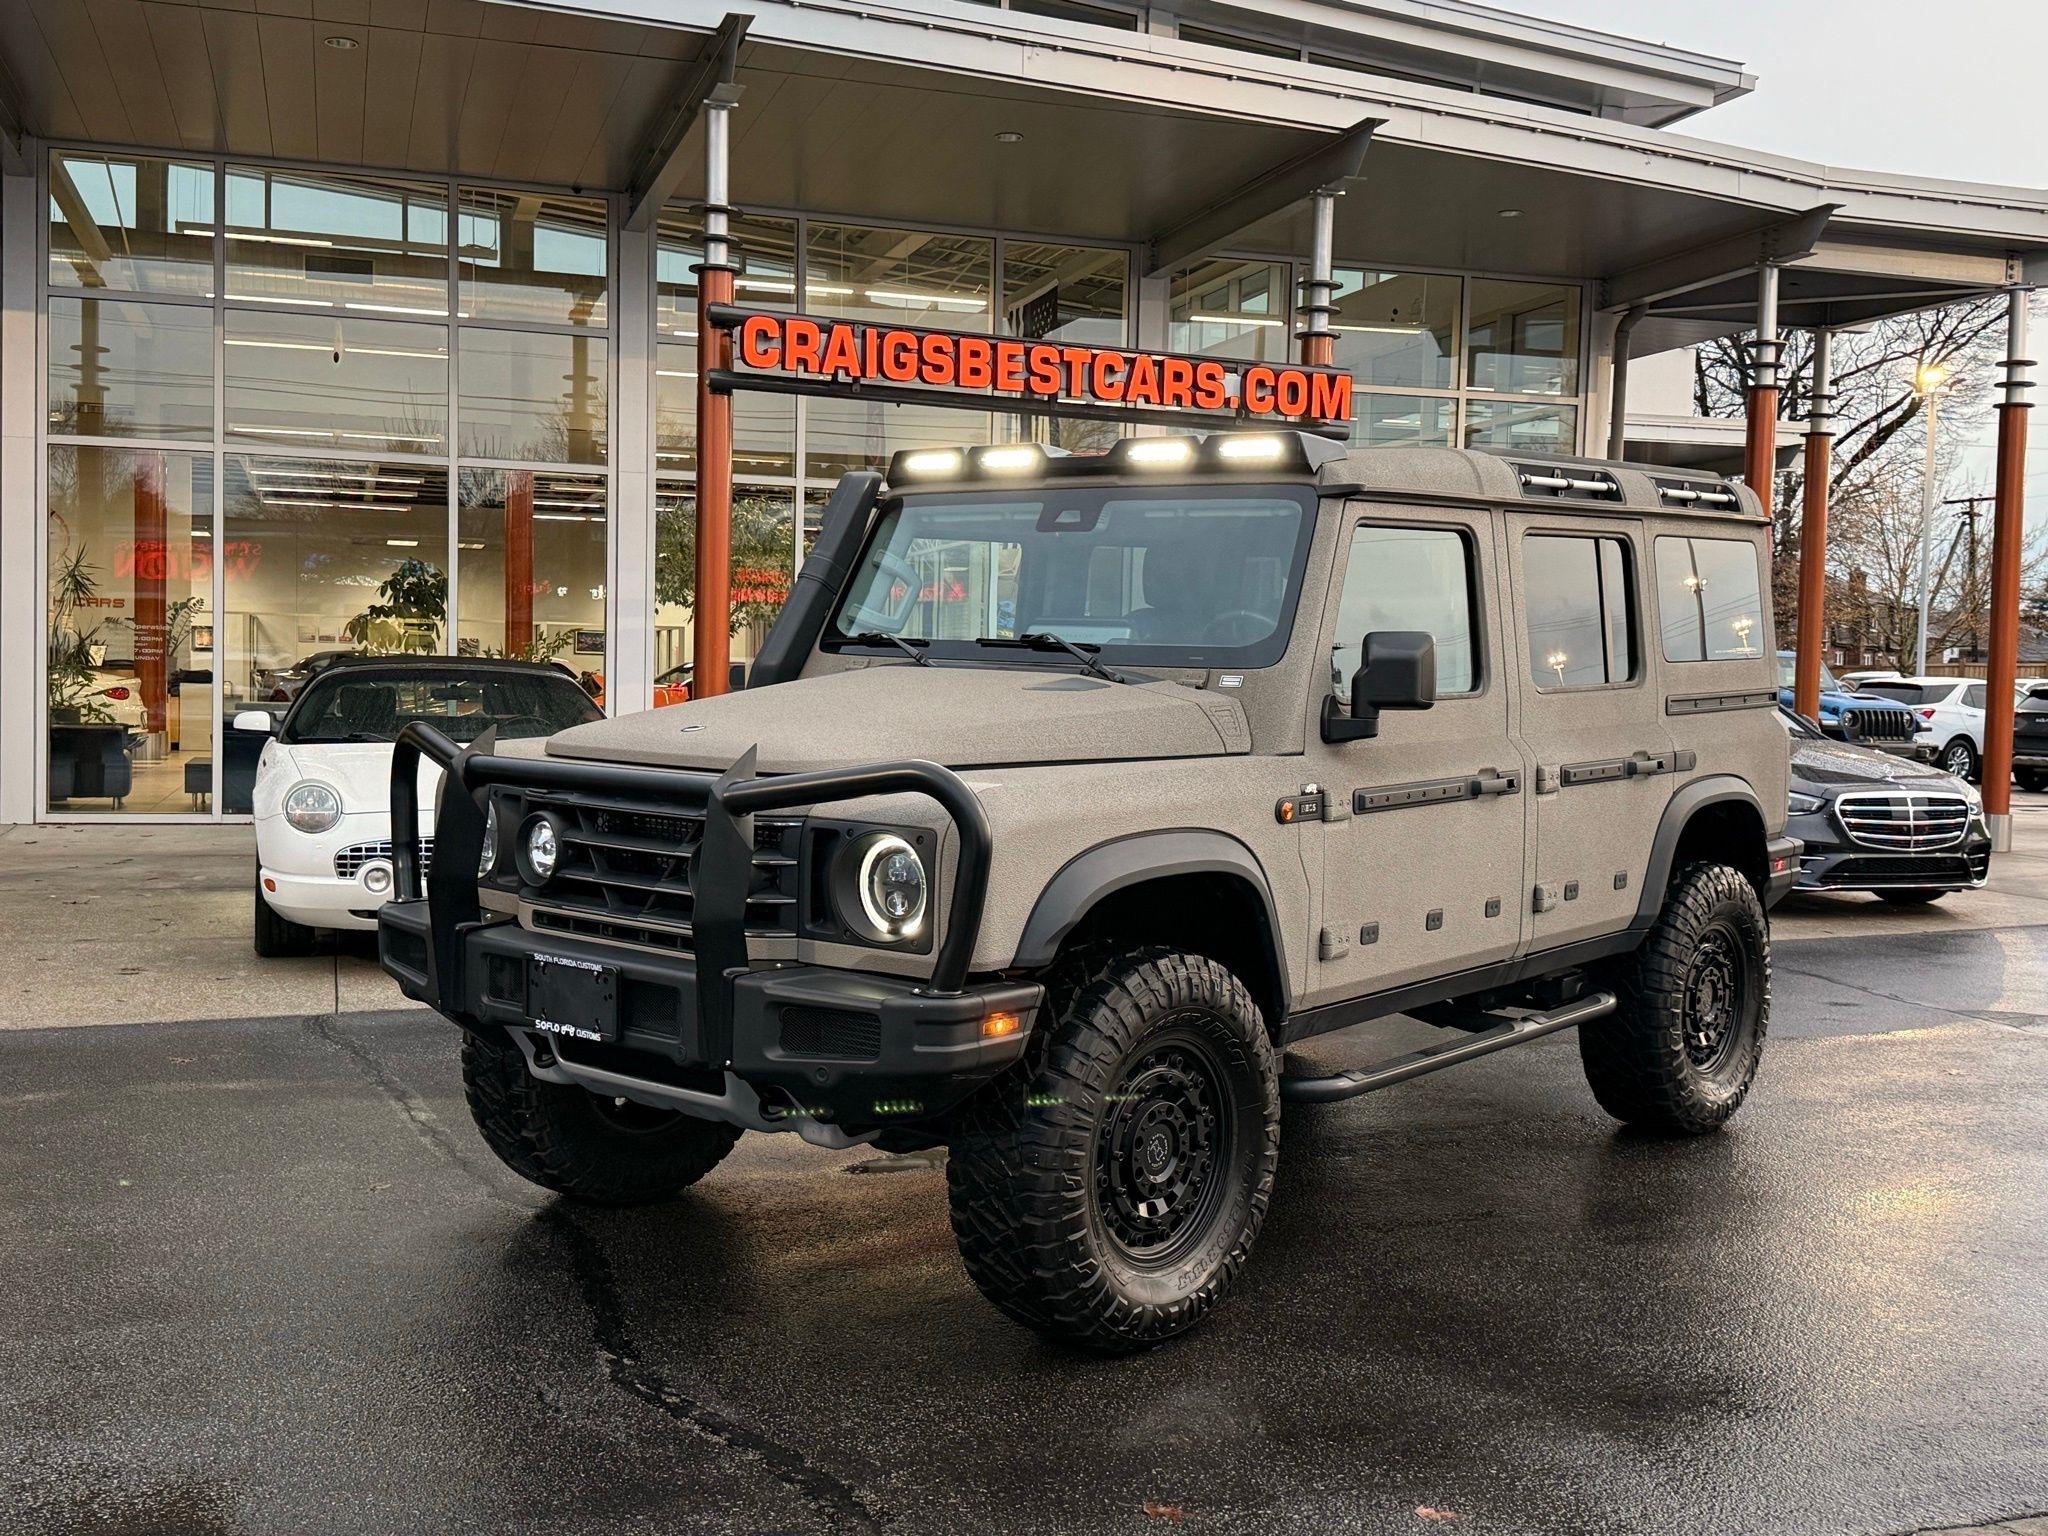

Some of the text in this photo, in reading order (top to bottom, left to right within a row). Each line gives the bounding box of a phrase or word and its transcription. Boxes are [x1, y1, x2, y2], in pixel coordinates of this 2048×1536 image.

[740, 315, 1352, 420] CRAIGSBESTCARS.COM
[534, 953, 603, 972] SOUTH FLORIDA CUSTOMS
[535, 1020, 602, 1042] SOFLO CUSTOMS
